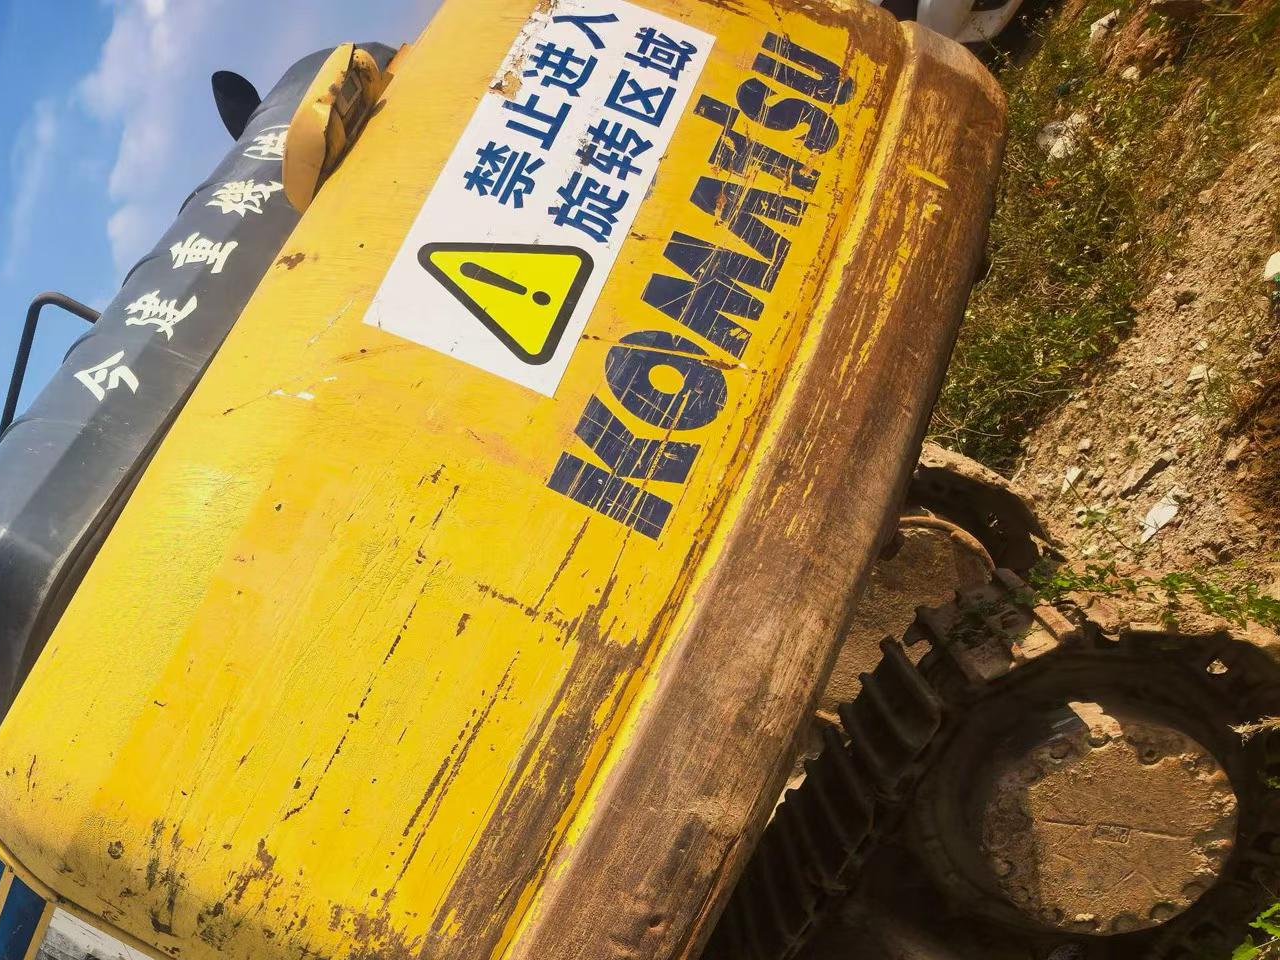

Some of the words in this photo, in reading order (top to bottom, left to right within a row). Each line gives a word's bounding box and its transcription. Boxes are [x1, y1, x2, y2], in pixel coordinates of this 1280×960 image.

[463, 13, 620, 209] 禁止进入
[548, 26, 698, 243] 旋转区域
[547, 31, 854, 540] KOMATSU
